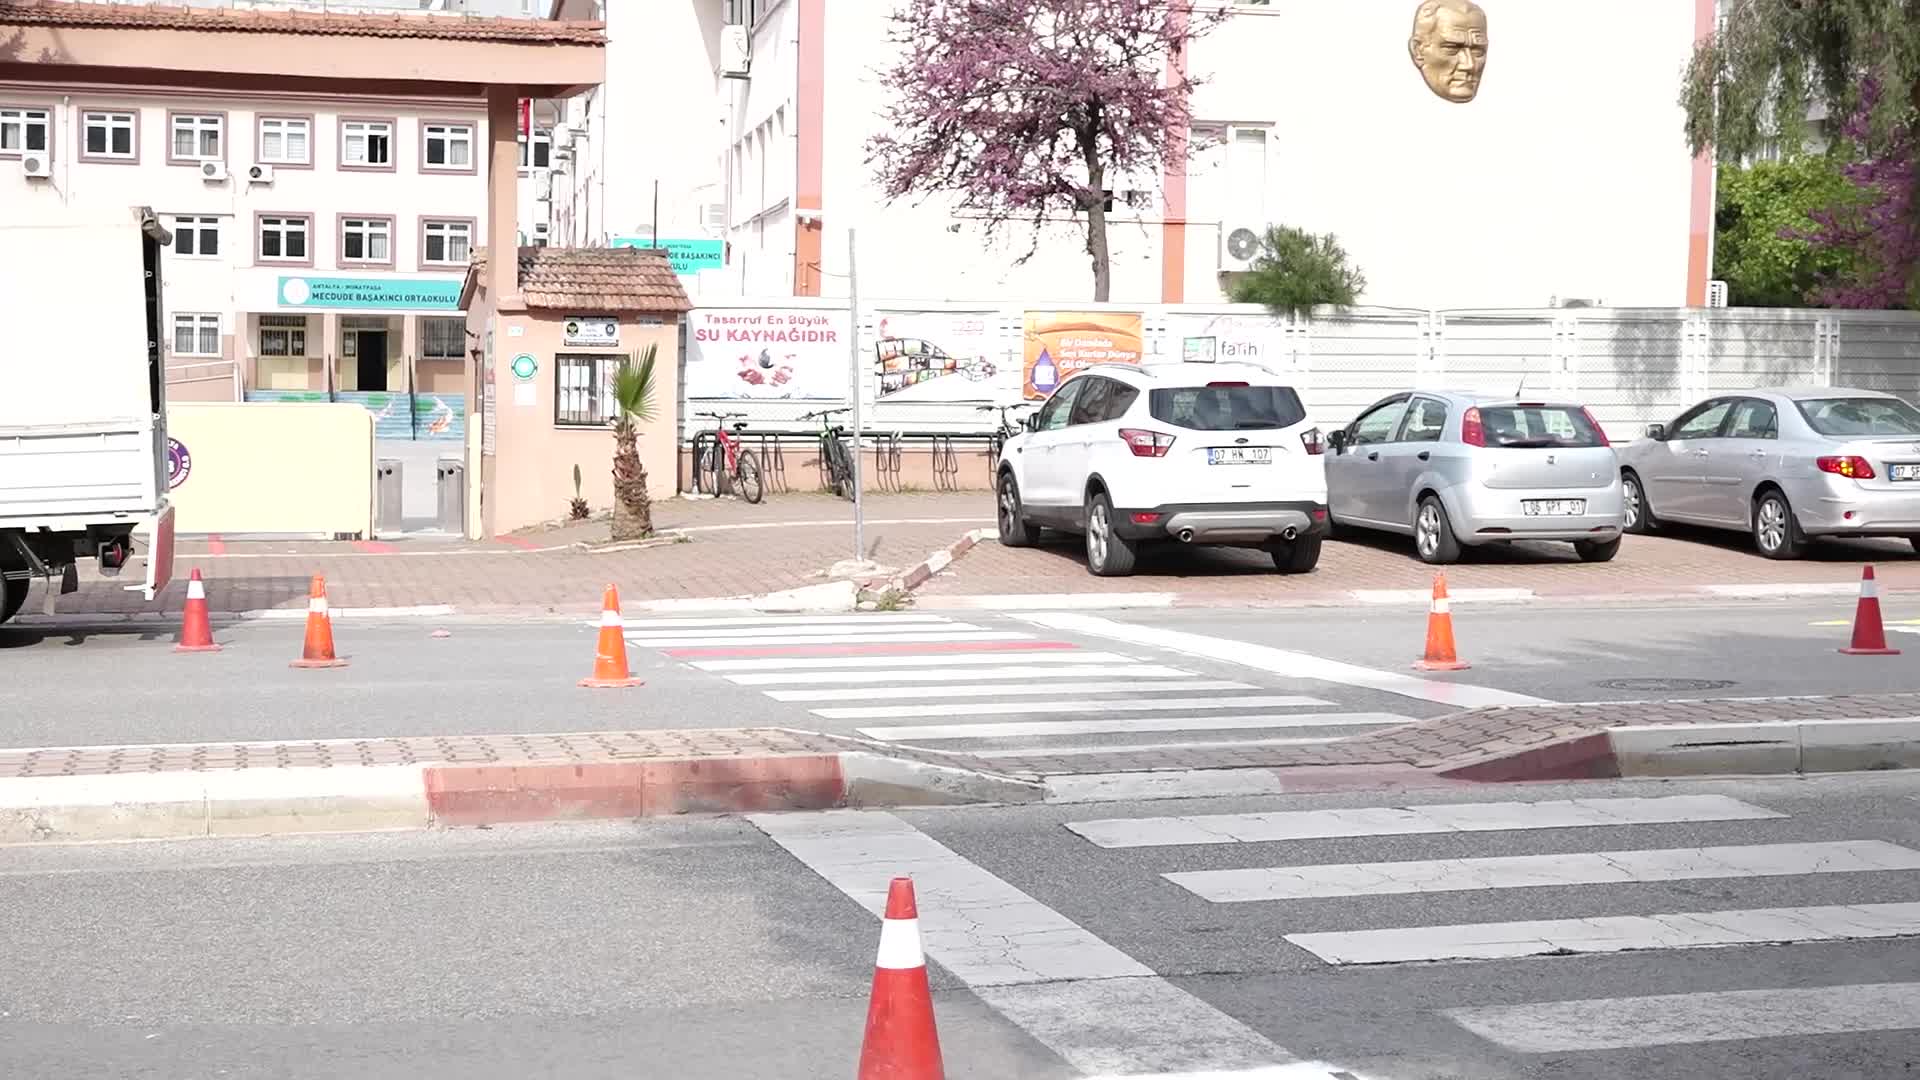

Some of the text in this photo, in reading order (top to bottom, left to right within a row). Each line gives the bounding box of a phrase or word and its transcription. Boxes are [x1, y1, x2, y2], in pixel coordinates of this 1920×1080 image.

[312, 292, 456, 304] MECDUDE BAŞAKINCI ORTAOKULU
[704, 314, 829, 327] Tasarruf En Büyük
[695, 328, 837, 342] SU KAYNAĞIDIR
[1215, 449, 1225, 460] 07
[1252, 449, 1268, 459] 107
[1895, 466, 1905, 476] 07
[1570, 501, 1581, 512] 01
